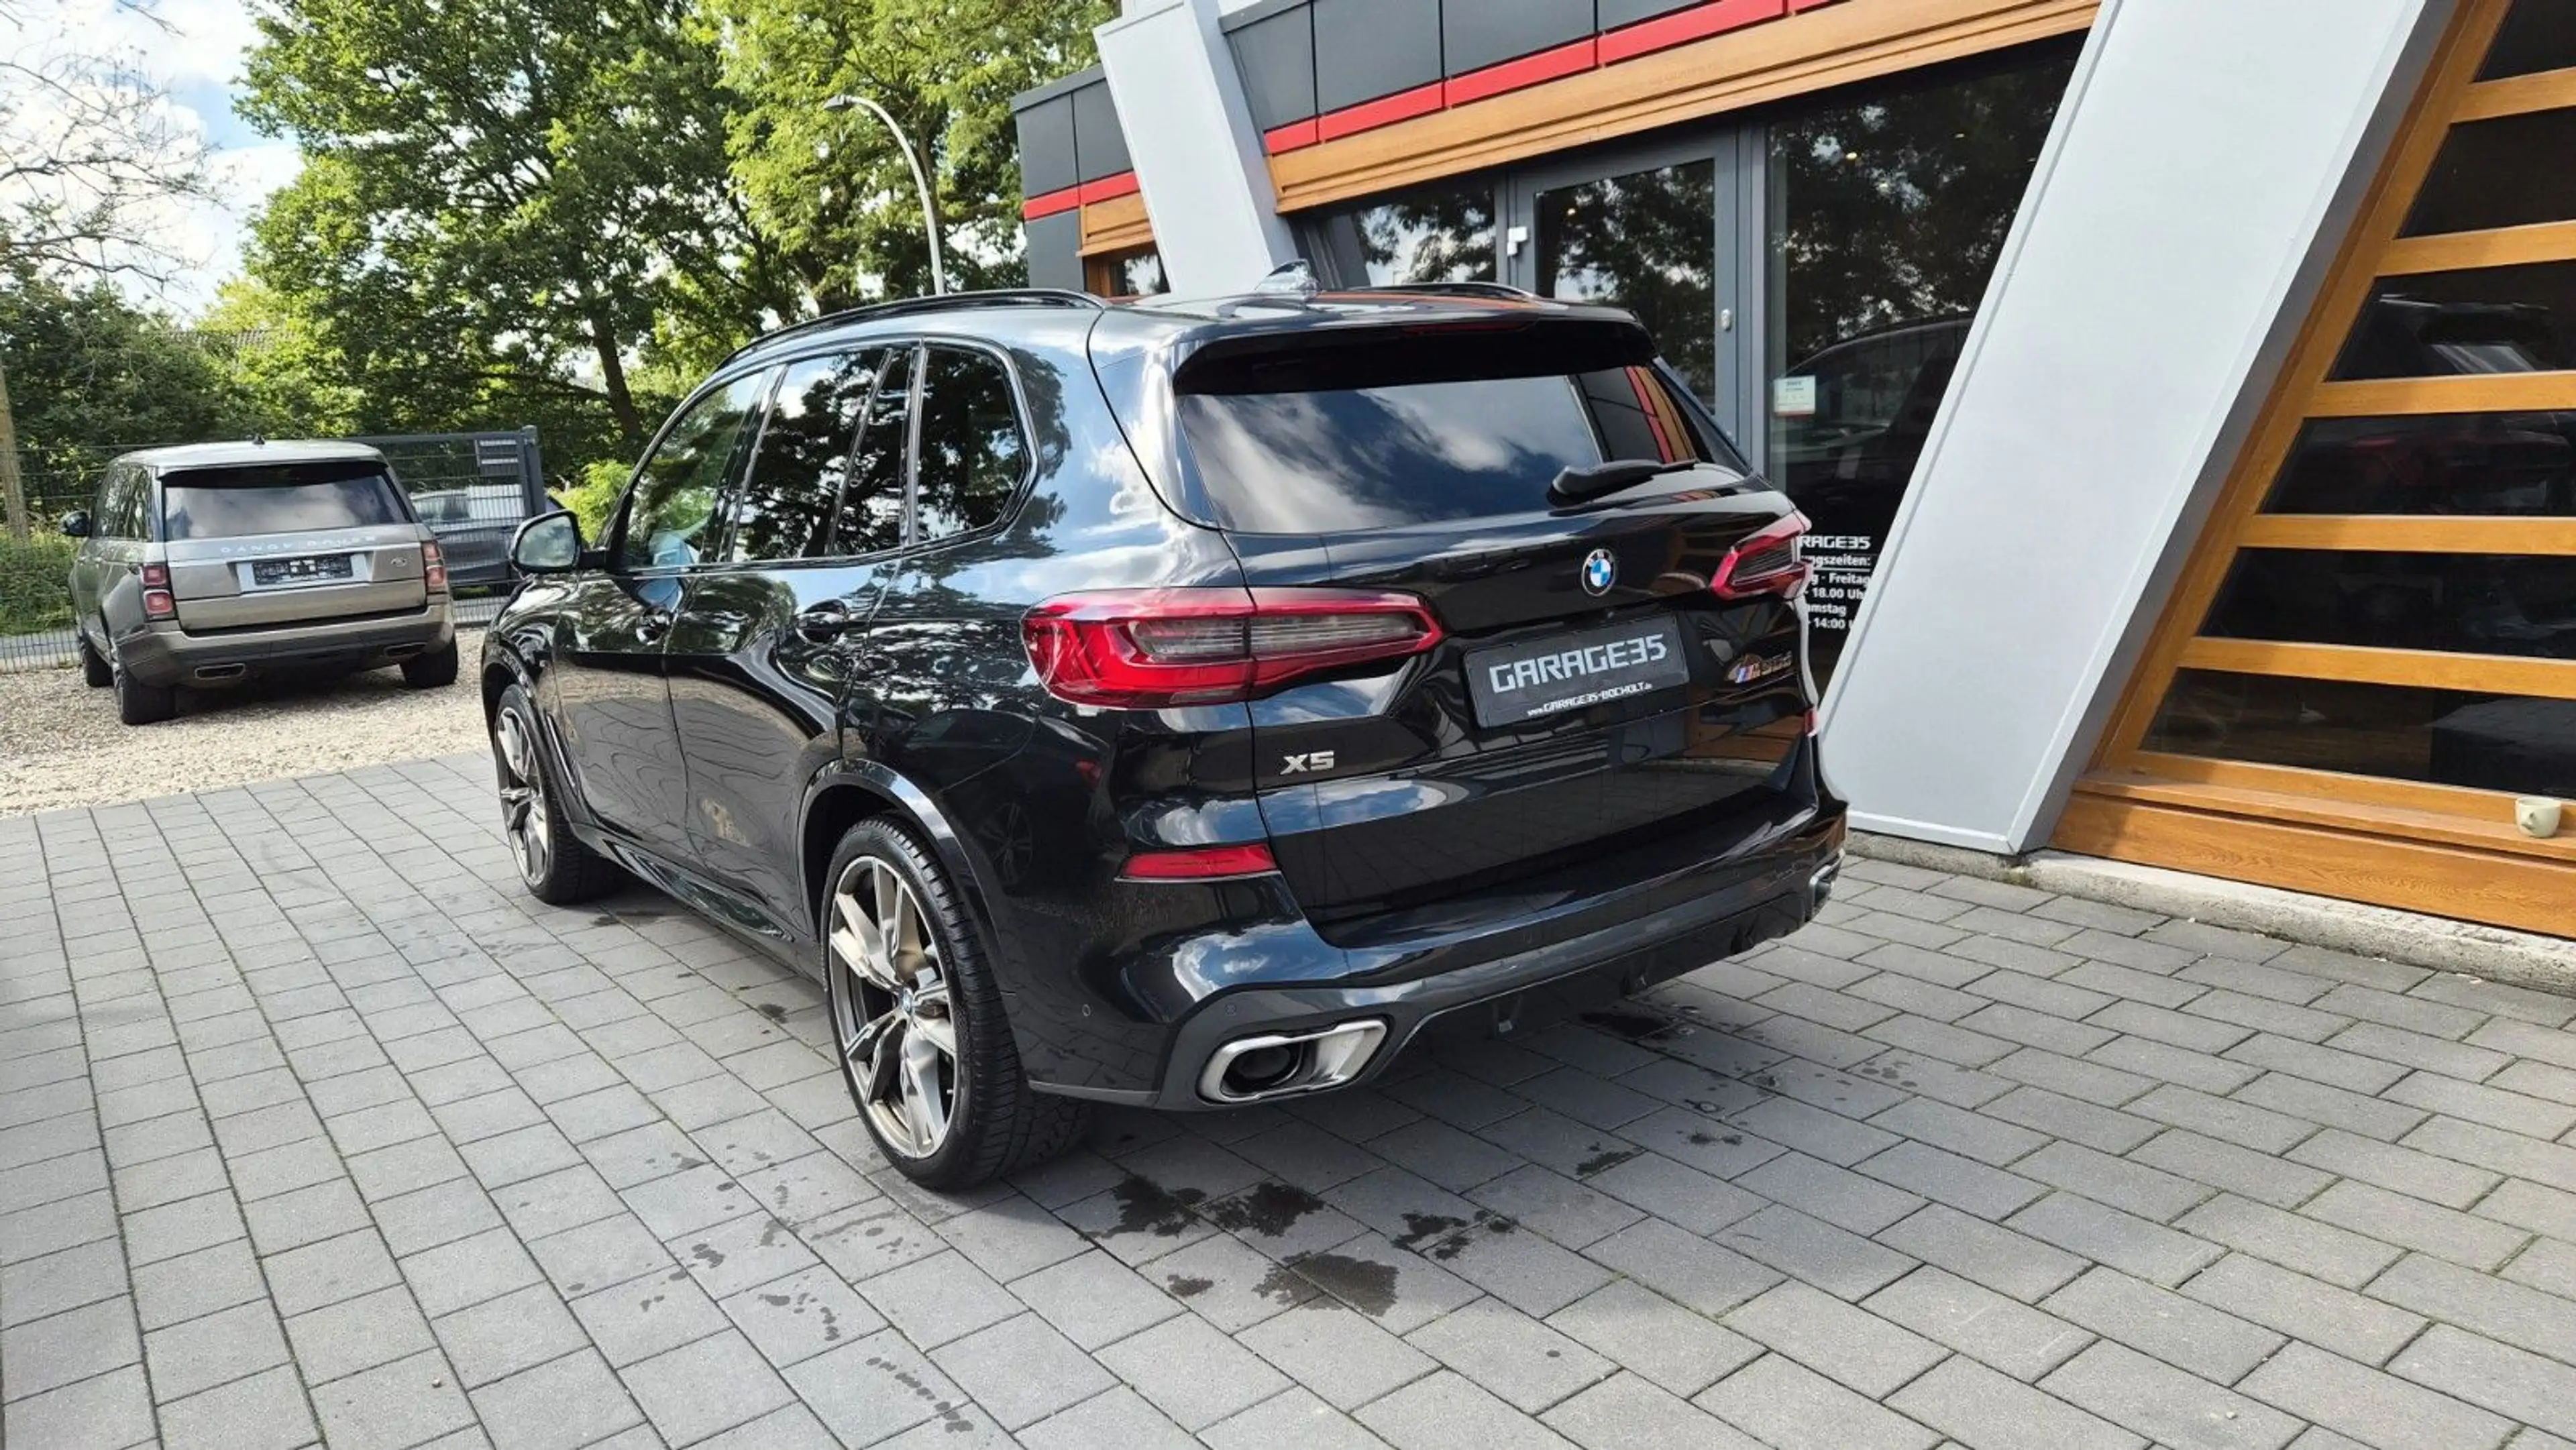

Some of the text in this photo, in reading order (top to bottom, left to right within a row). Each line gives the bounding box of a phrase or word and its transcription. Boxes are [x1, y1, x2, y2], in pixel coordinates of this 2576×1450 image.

[1801, 536, 1872, 550] RAGE35
[1801, 554, 1871, 567] ngszeiten:
[1829, 572, 1870, 588] Freitag
[1812, 588, 1844, 598] 18.00
[1847, 588, 1865, 600] Uh
[1808, 604, 1846, 617] mstag
[1813, 617, 1845, 629] 14:00
[1489, 634, 1667, 693] GARAGE35
[1280, 750, 1334, 775] X5
